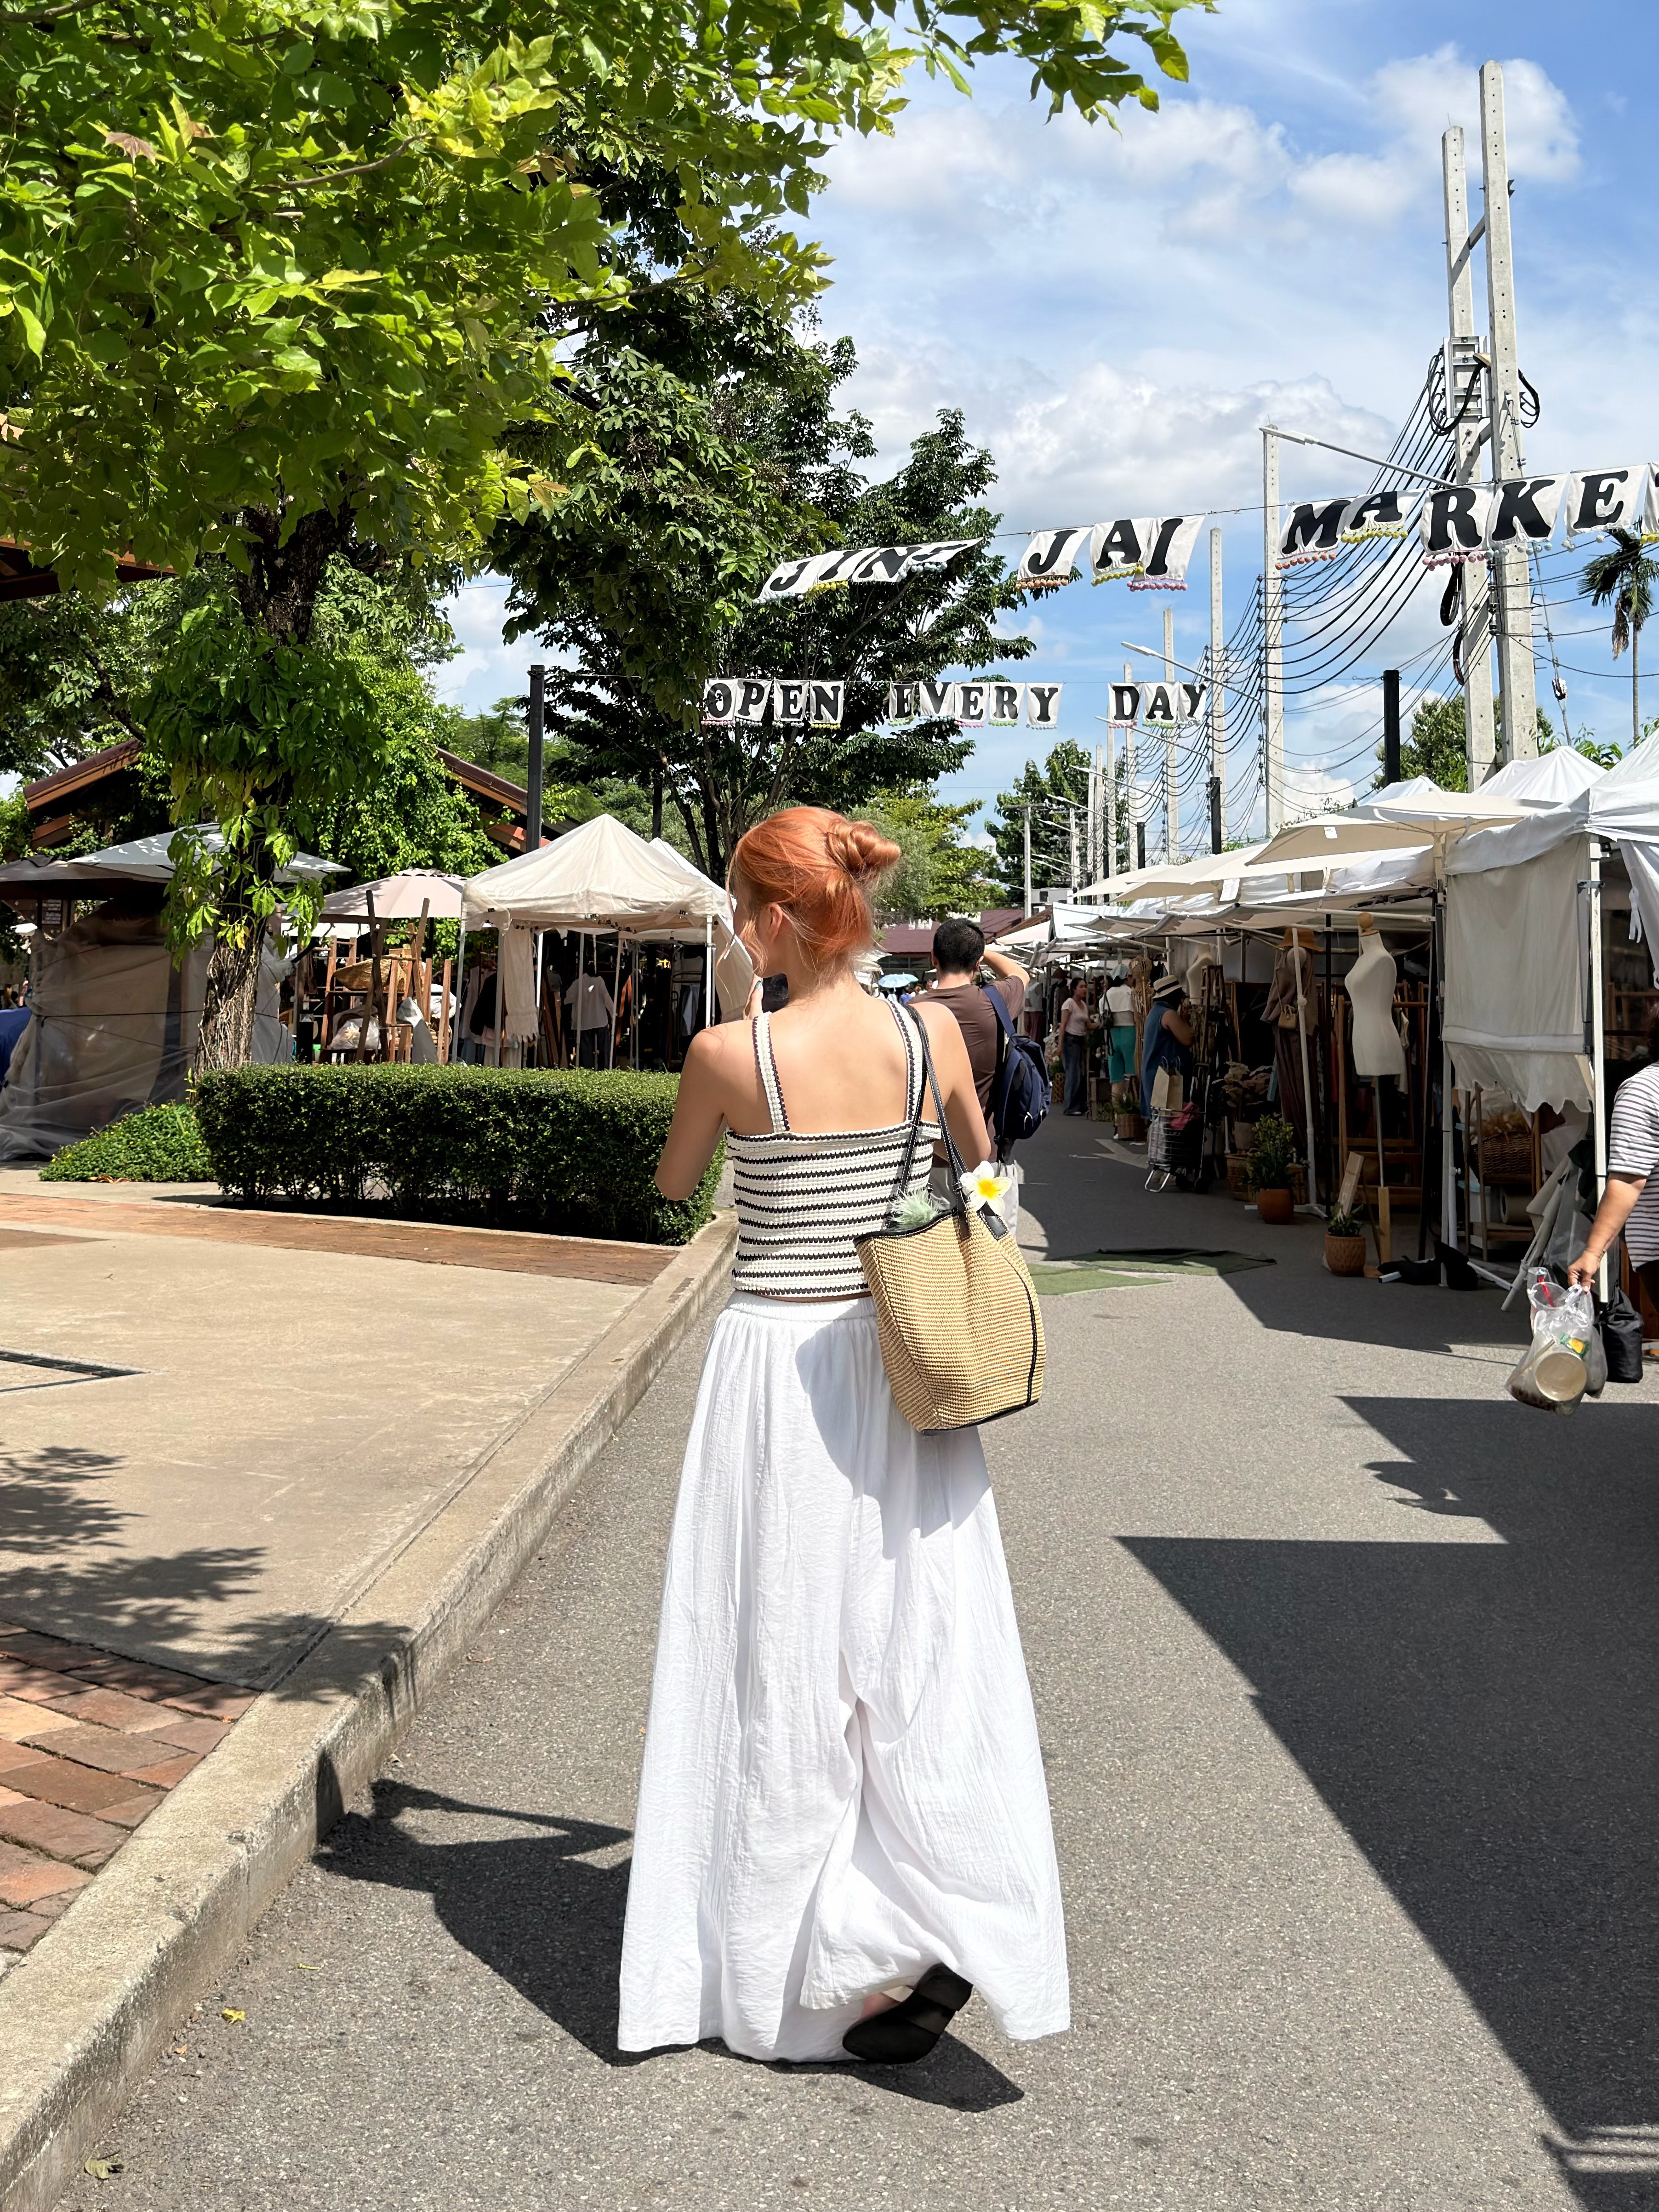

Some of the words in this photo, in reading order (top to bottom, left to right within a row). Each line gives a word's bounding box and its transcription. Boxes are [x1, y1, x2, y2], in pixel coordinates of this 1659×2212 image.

[1027, 518, 1183, 576] JAI
[1282, 470, 1659, 553] MARKE
[707, 681, 841, 721] OPEN
[894, 682, 1058, 722] EVERY
[1112, 684, 1207, 720] DAY
